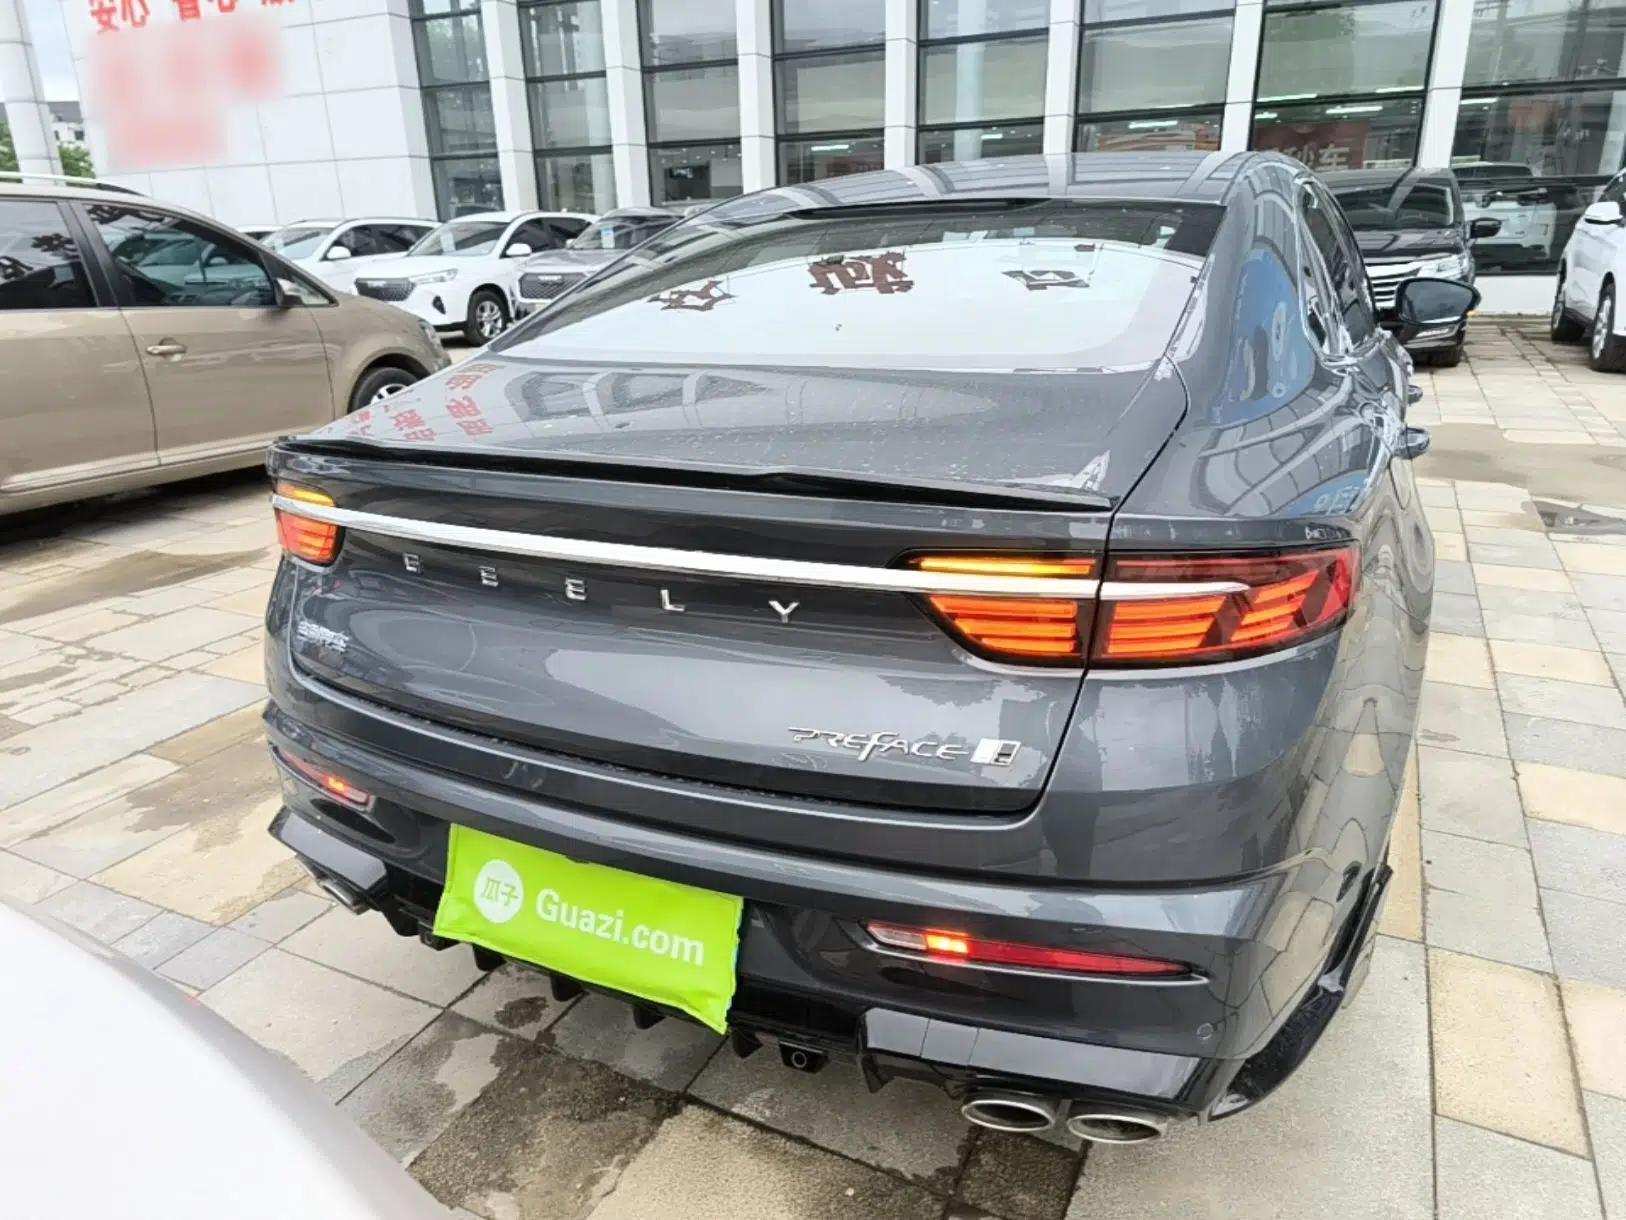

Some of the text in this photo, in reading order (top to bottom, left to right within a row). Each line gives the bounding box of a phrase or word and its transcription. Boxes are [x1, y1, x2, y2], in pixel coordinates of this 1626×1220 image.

[402, 552, 800, 623] GEELY
[787, 726, 969, 762] PREFACE
[482, 876, 705, 967] 瓜子 Guazi.com
